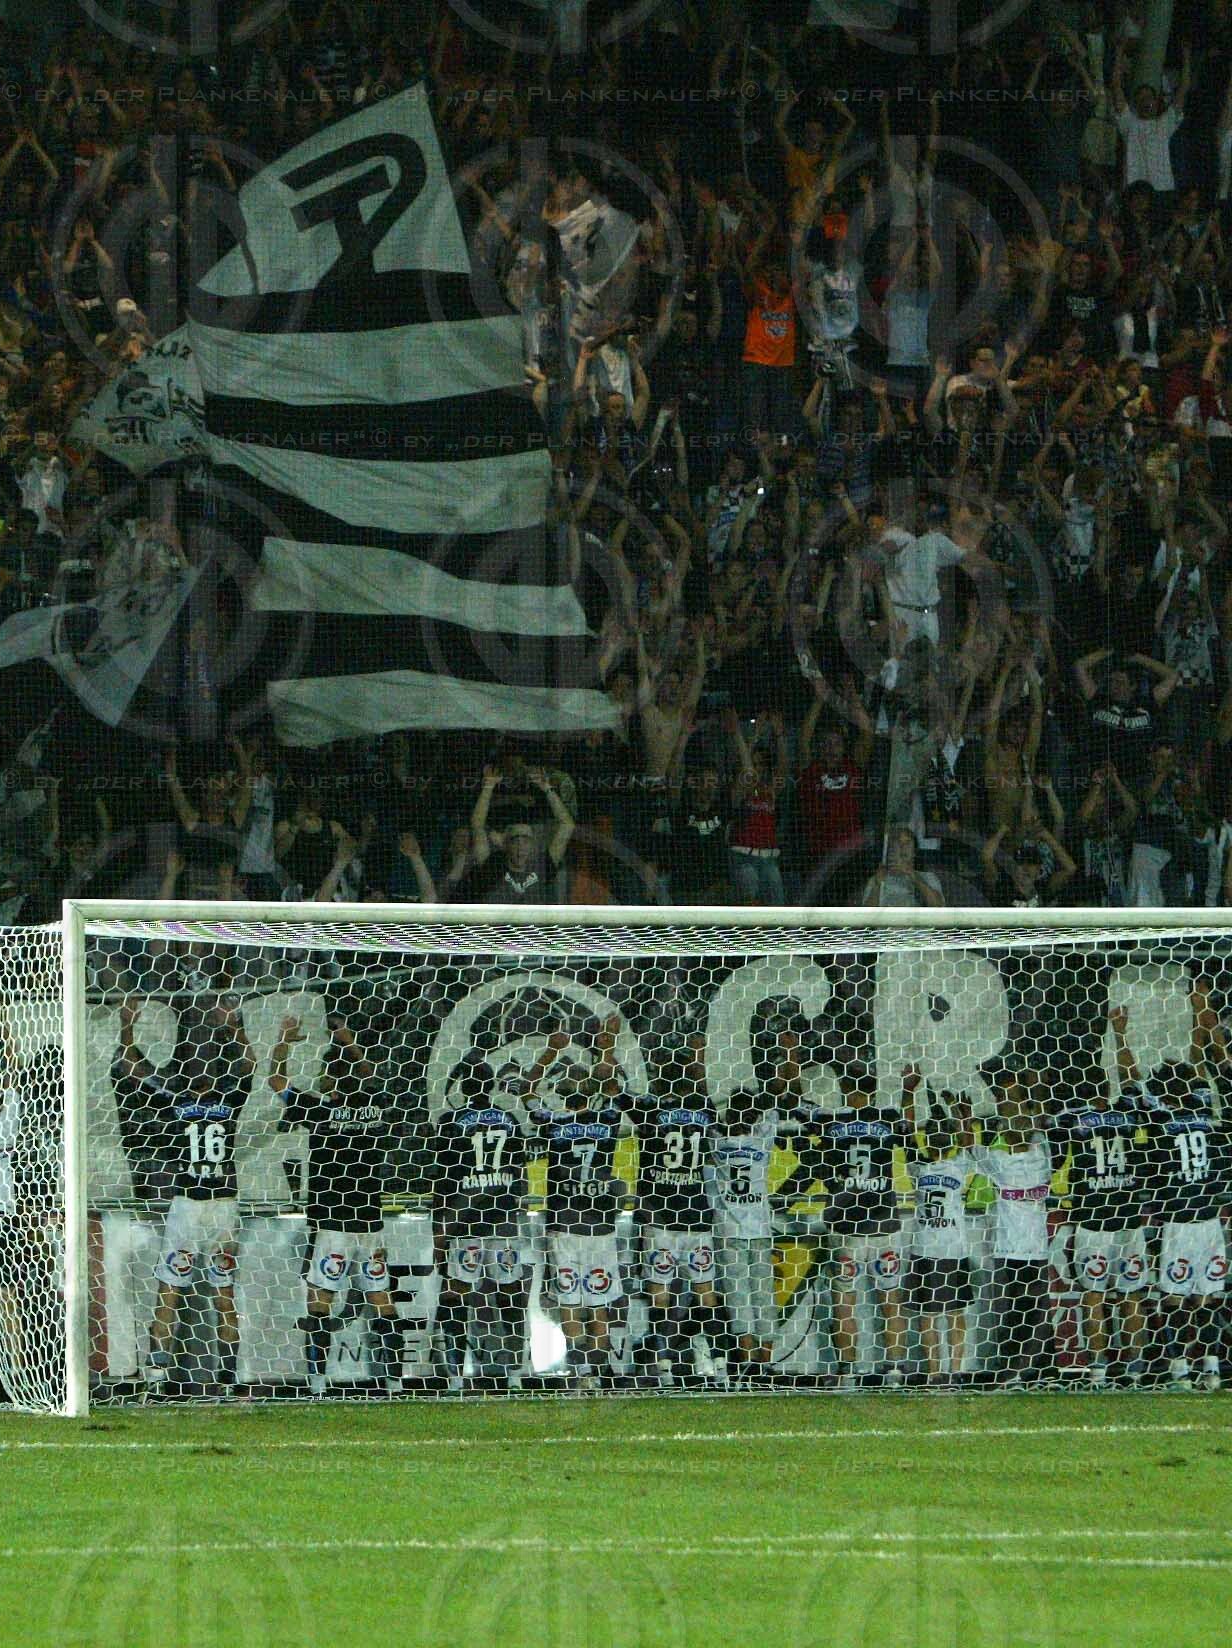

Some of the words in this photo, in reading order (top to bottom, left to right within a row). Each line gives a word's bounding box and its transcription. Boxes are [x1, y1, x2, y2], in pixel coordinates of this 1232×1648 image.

[184, 1123, 226, 1162] 16
[471, 1129, 507, 1171] 17
[573, 1142, 596, 1183] 7
[663, 1131, 702, 1169] 31
[849, 1144, 872, 1179] 5
[1090, 1135, 1127, 1175] 14
[1174, 1130, 1208, 1171] 19
